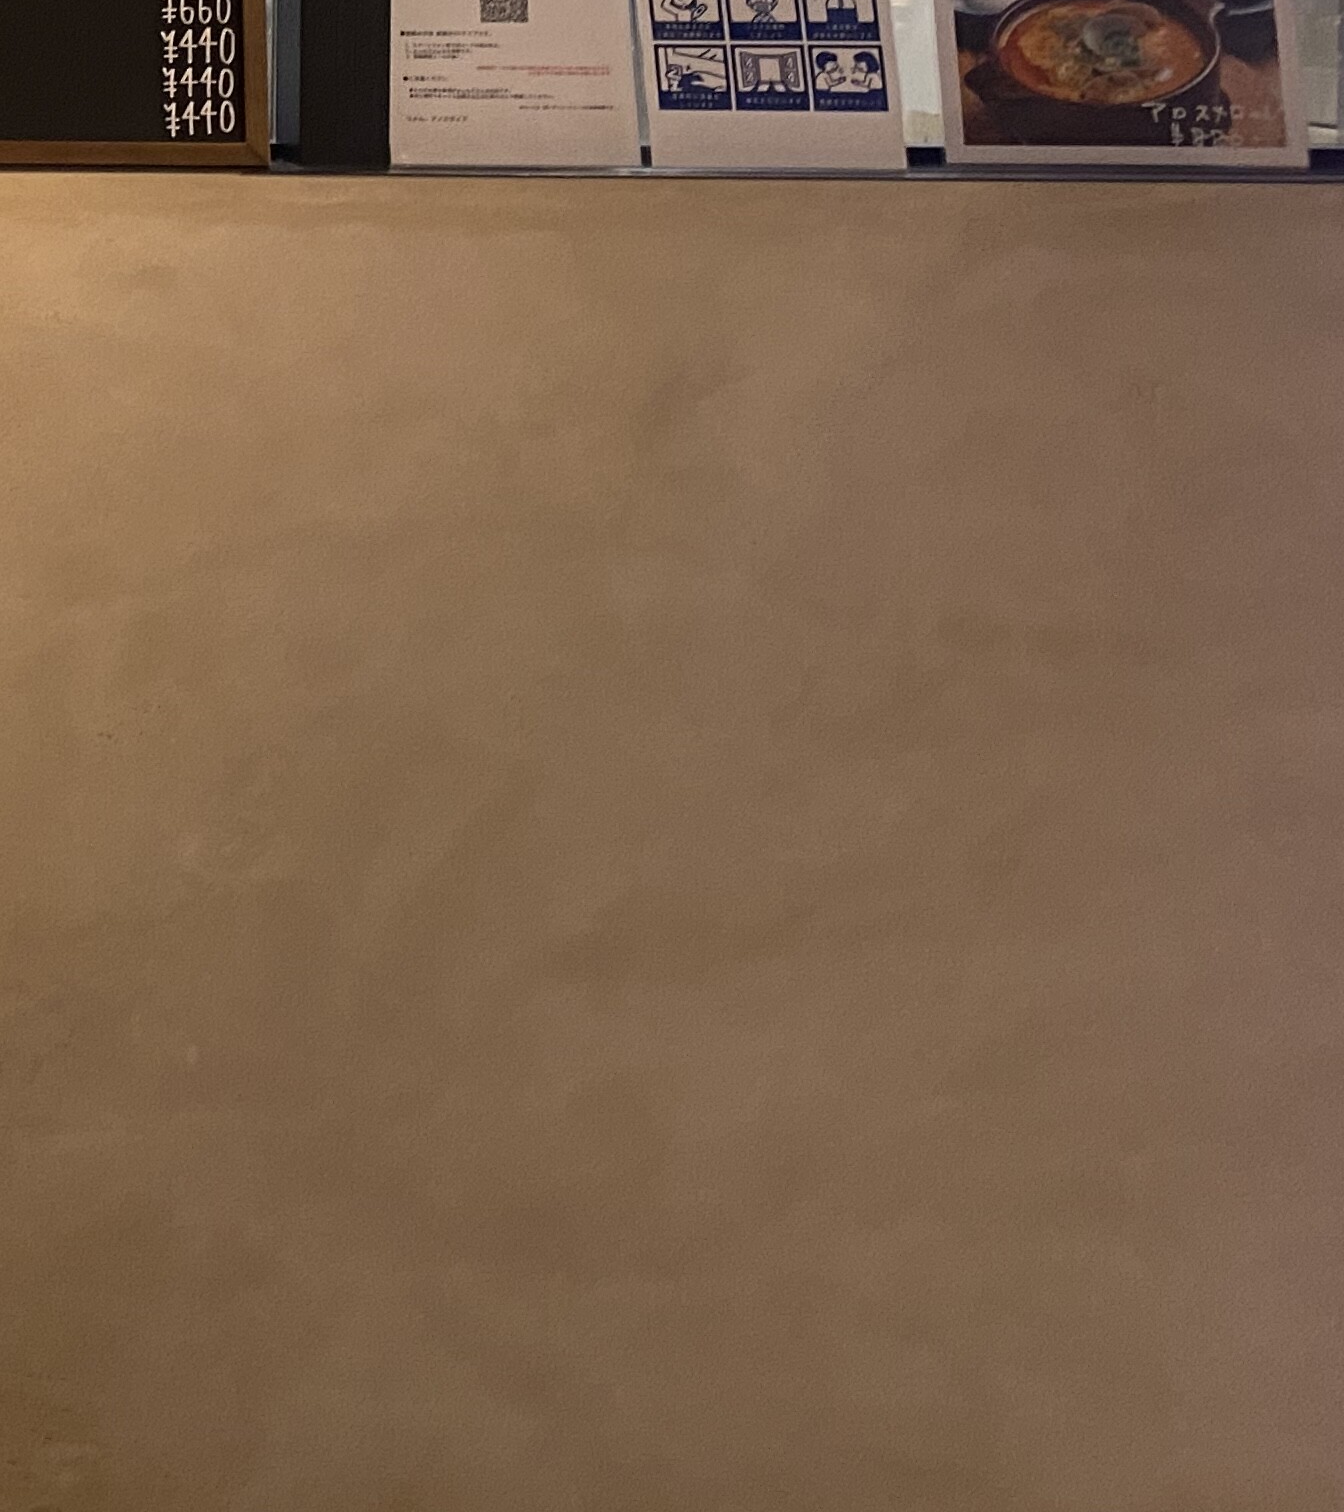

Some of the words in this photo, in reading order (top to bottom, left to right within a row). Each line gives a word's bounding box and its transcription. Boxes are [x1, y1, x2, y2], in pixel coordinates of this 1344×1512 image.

[160, 26, 236, 65] ¥440
[162, 65, 235, 99] ¥440
[163, 98, 236, 138] ¥440
